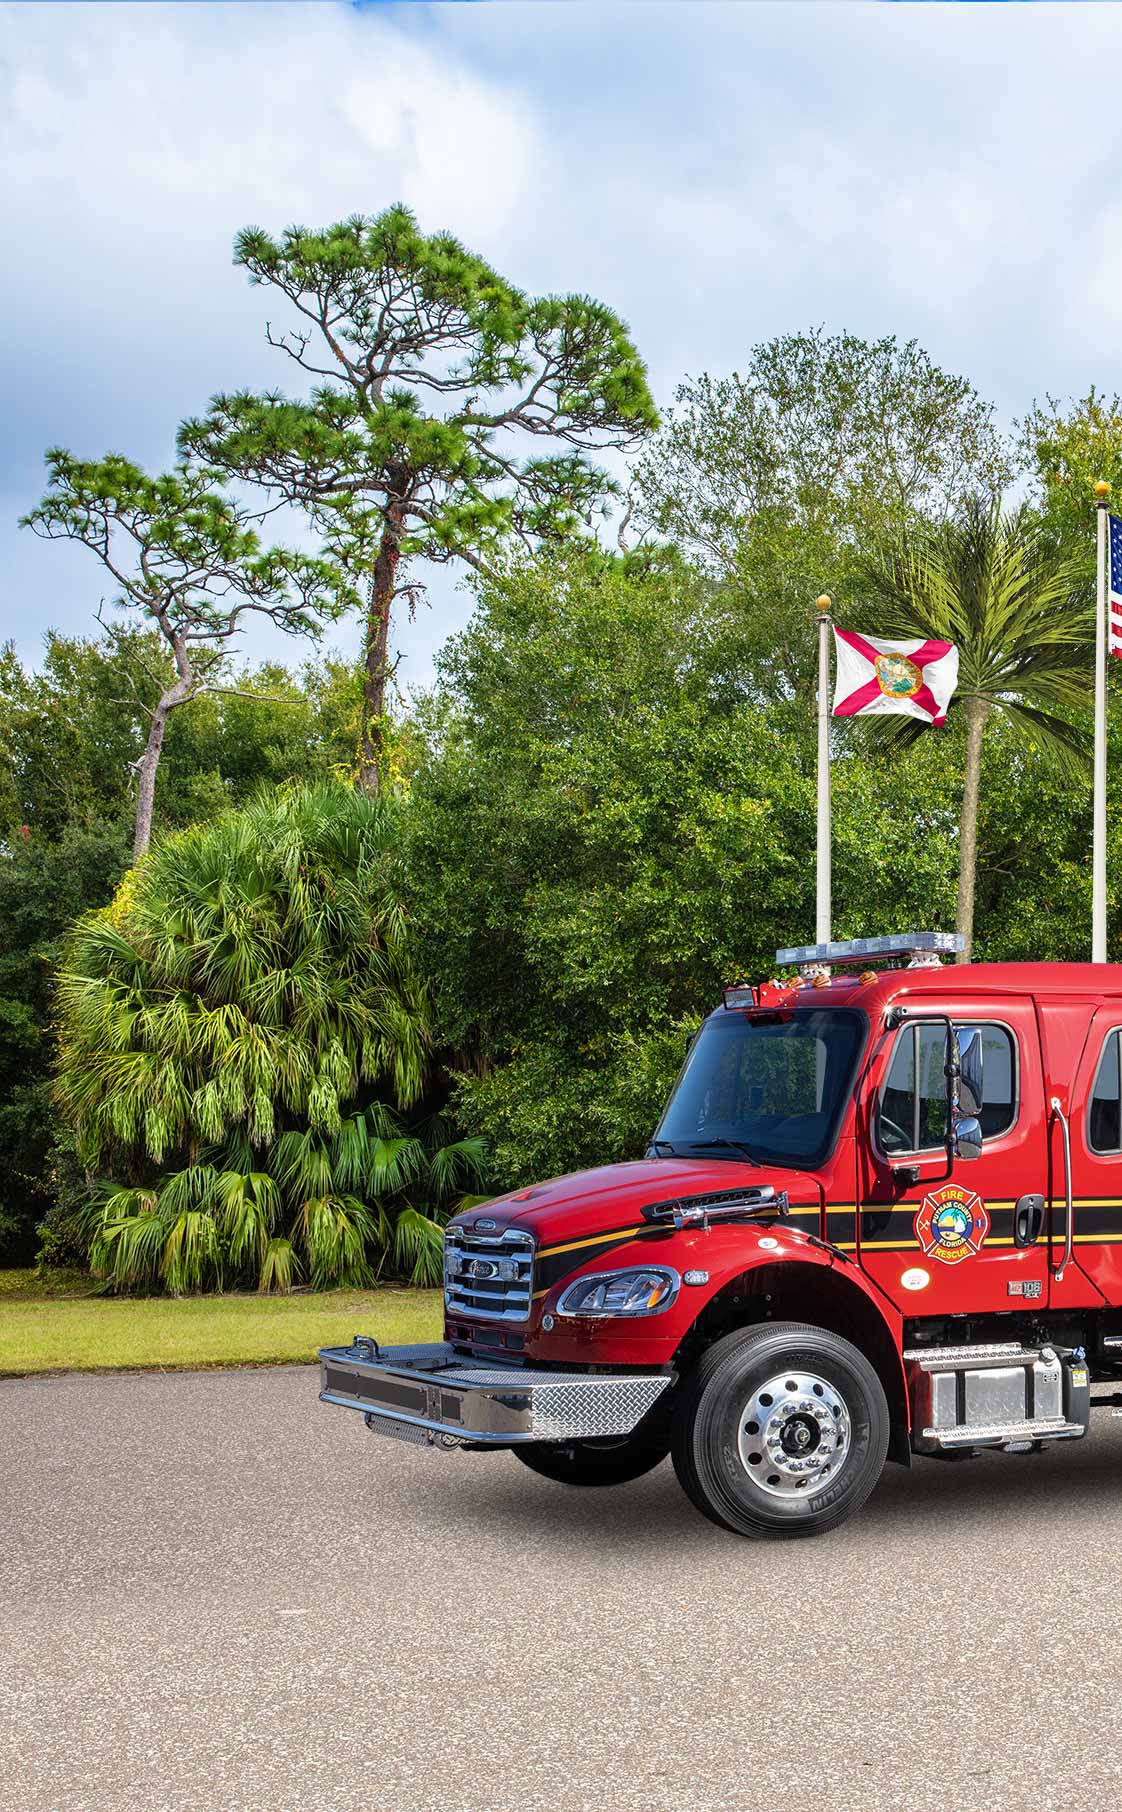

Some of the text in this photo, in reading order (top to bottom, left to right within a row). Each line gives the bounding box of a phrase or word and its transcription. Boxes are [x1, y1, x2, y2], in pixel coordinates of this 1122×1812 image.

[941, 1190, 964, 1200] FIRE
[933, 1201, 973, 1224] PUTNAM COUNTY
[939, 1236, 967, 1248] FLORIDA
[935, 1246, 969, 1259] RESCUE
